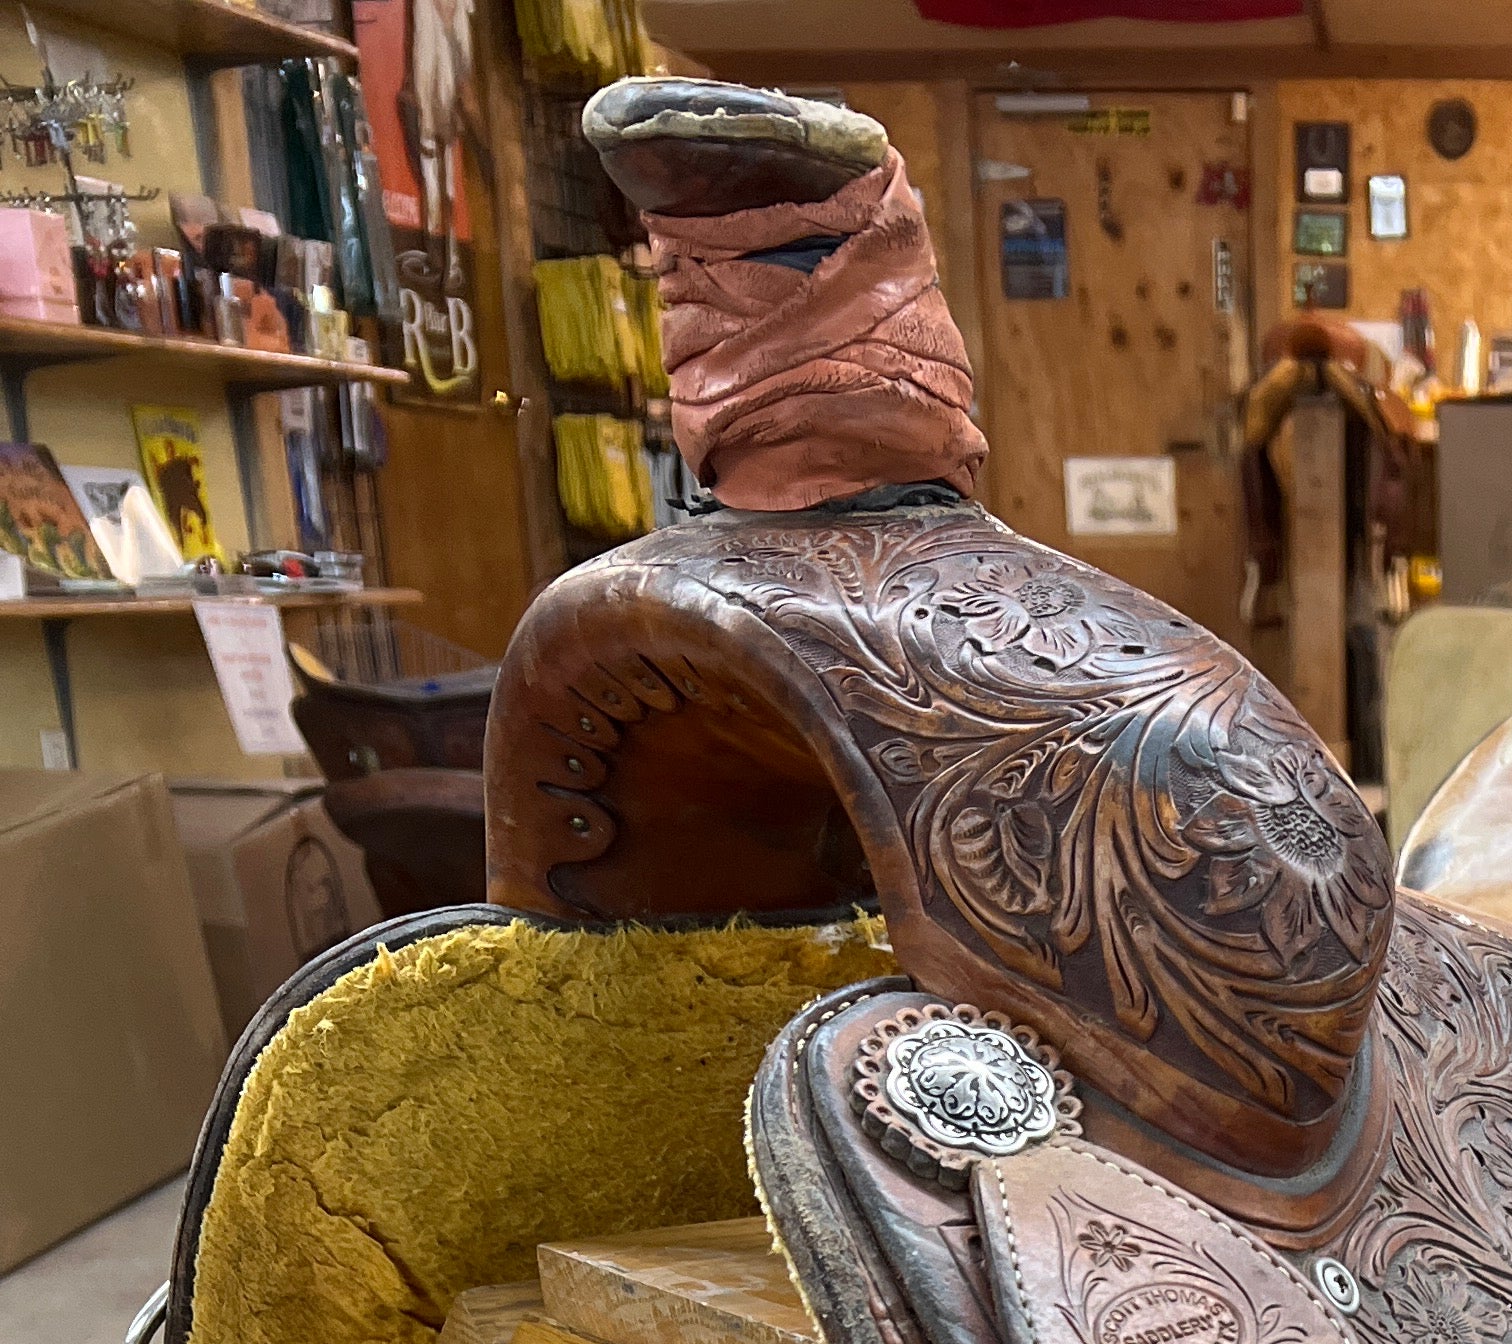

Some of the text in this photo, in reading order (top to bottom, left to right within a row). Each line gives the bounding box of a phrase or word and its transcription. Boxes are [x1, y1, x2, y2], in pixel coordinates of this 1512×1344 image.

[446, 297, 478, 376] B
[1103, 1288, 1227, 1344] SCOTT THOMAS
